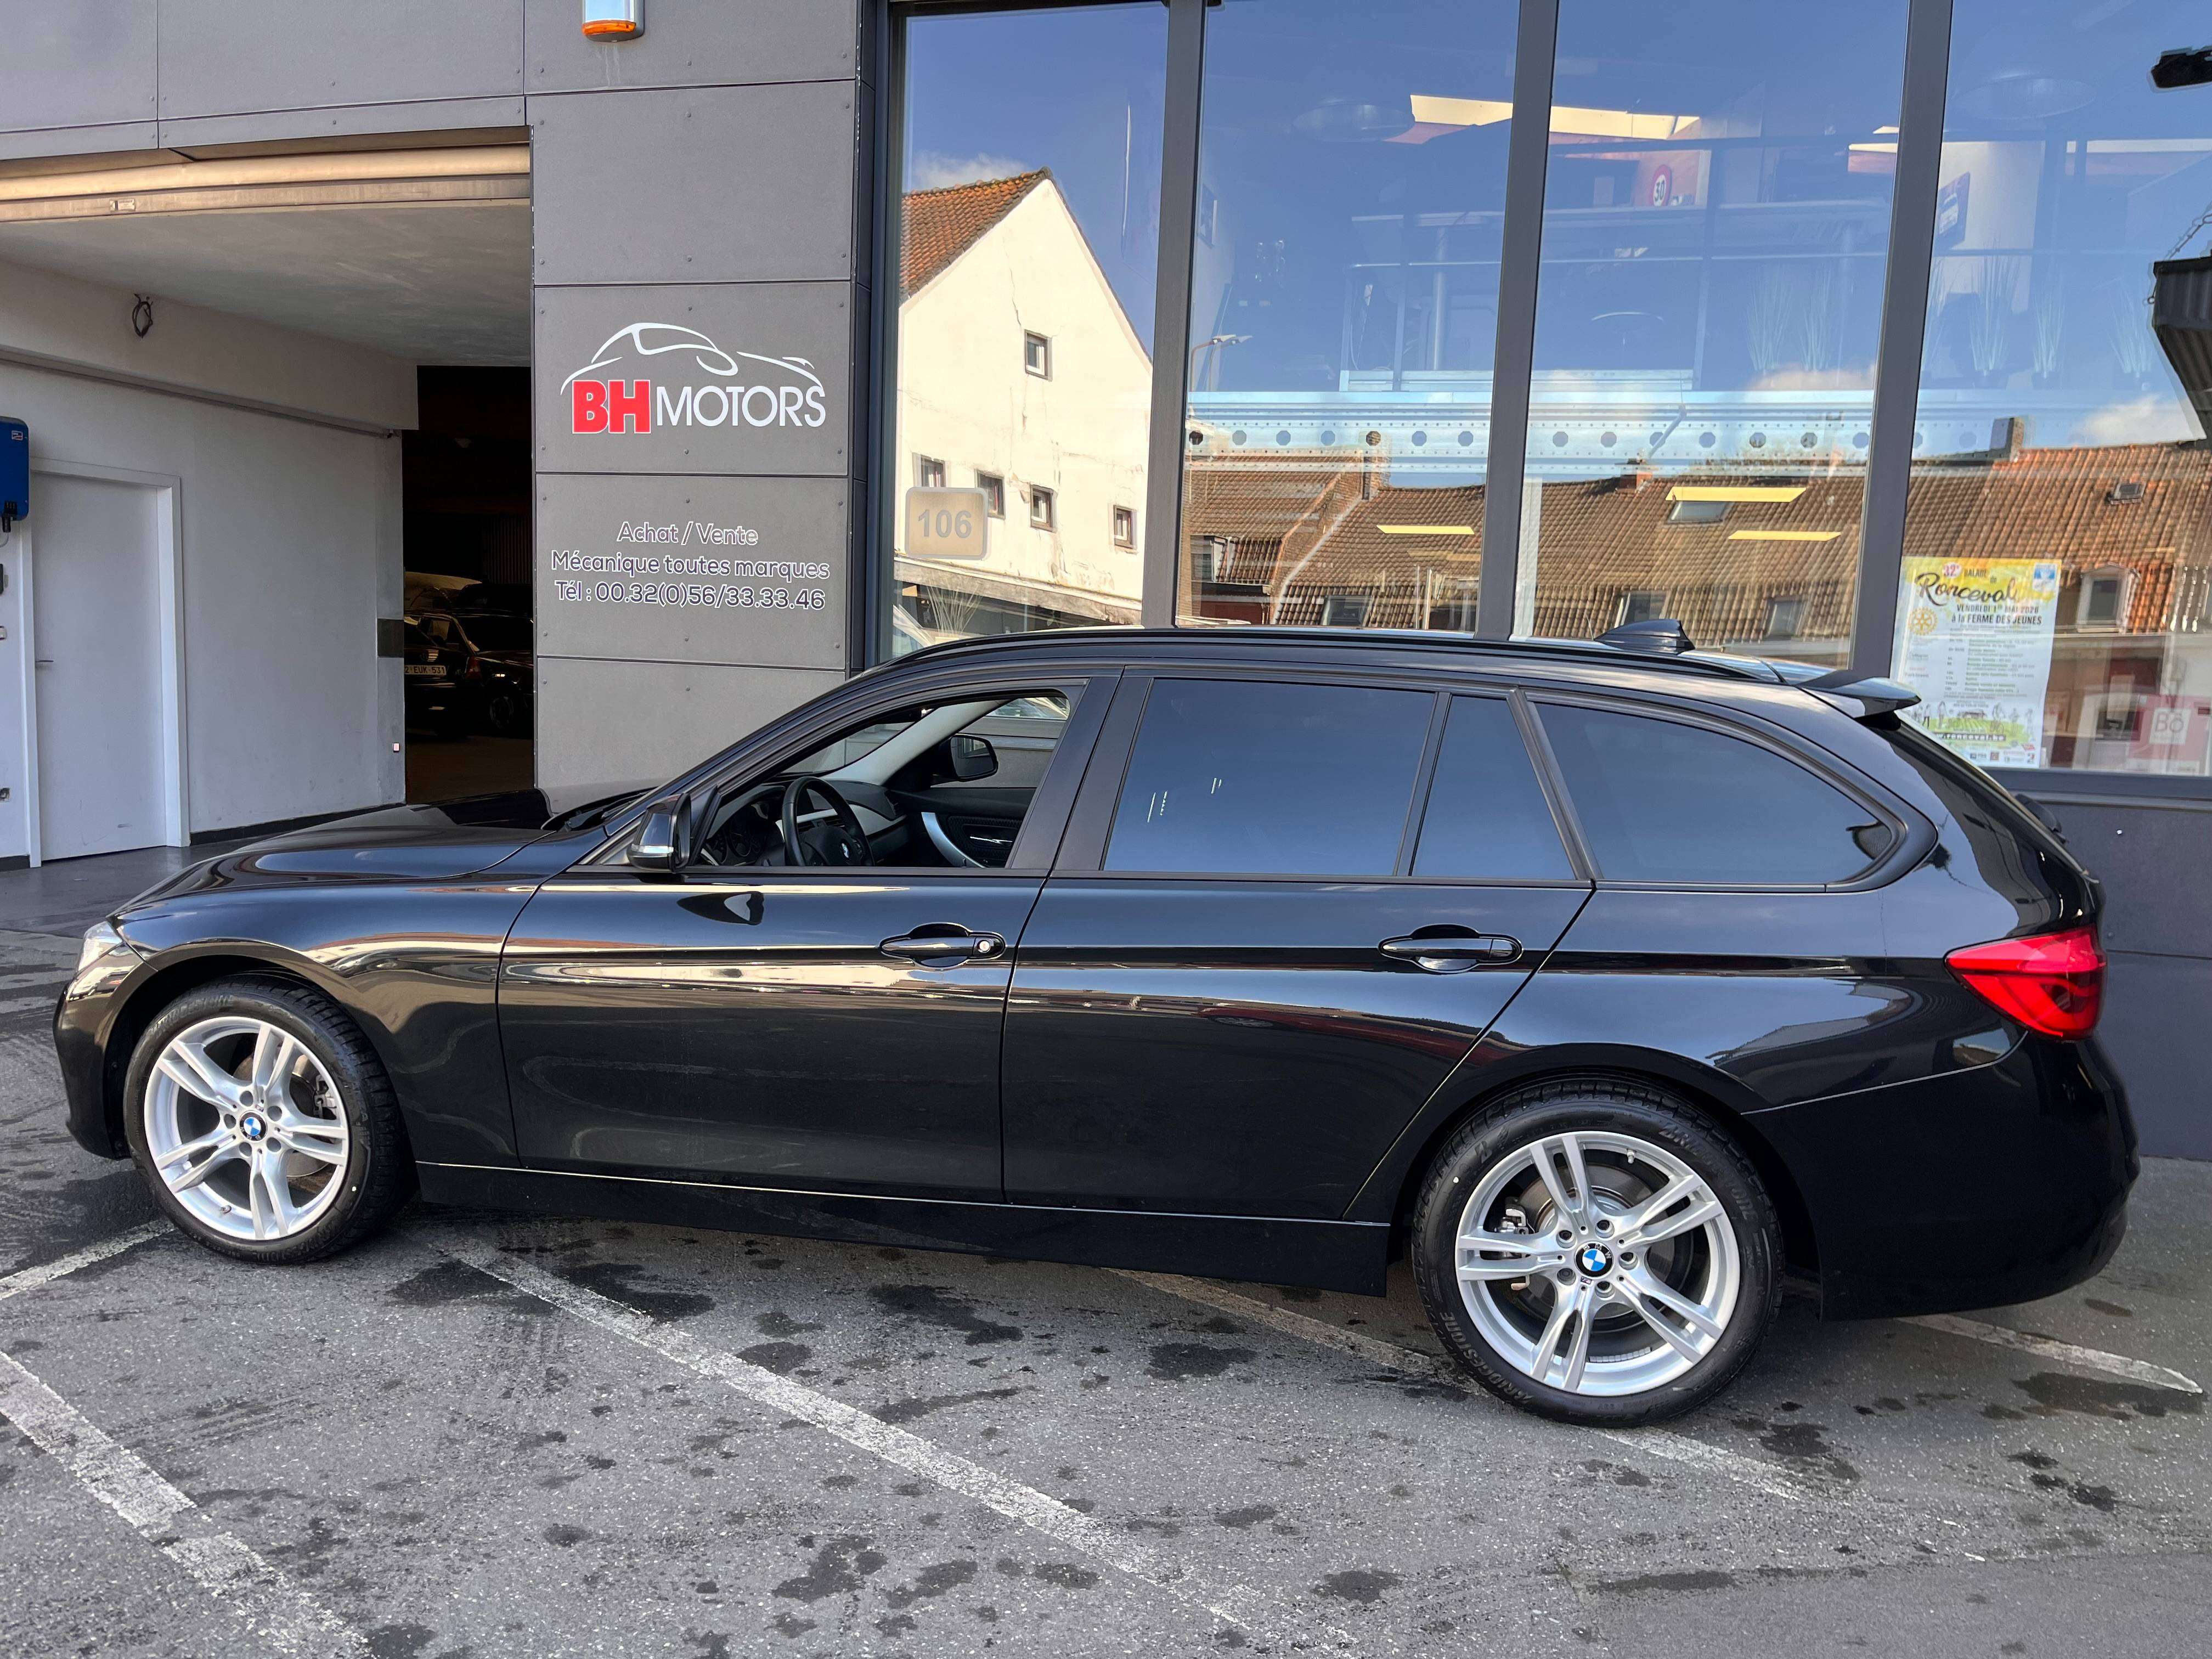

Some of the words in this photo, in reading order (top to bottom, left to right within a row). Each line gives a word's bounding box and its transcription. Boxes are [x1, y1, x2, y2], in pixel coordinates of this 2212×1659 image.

[1655, 180, 1665, 201] 30
[572, 380, 651, 434] BH
[657, 385, 826, 427] MOTORS
[617, 521, 678, 543] Achat
[696, 523, 759, 546] Vente
[917, 509, 973, 539] 106
[551, 550, 660, 578] Mécanique
[664, 555, 730, 575] toutes
[734, 560, 831, 583] marques
[595, 581, 826, 611] 00.32(0)56/33.33.46
[1915, 572, 2017, 606] Ronceval
[1967, 614, 1994, 624] FERME
[1996, 614, 2011, 624] DES
[2012, 615, 2042, 625] JEUNES
